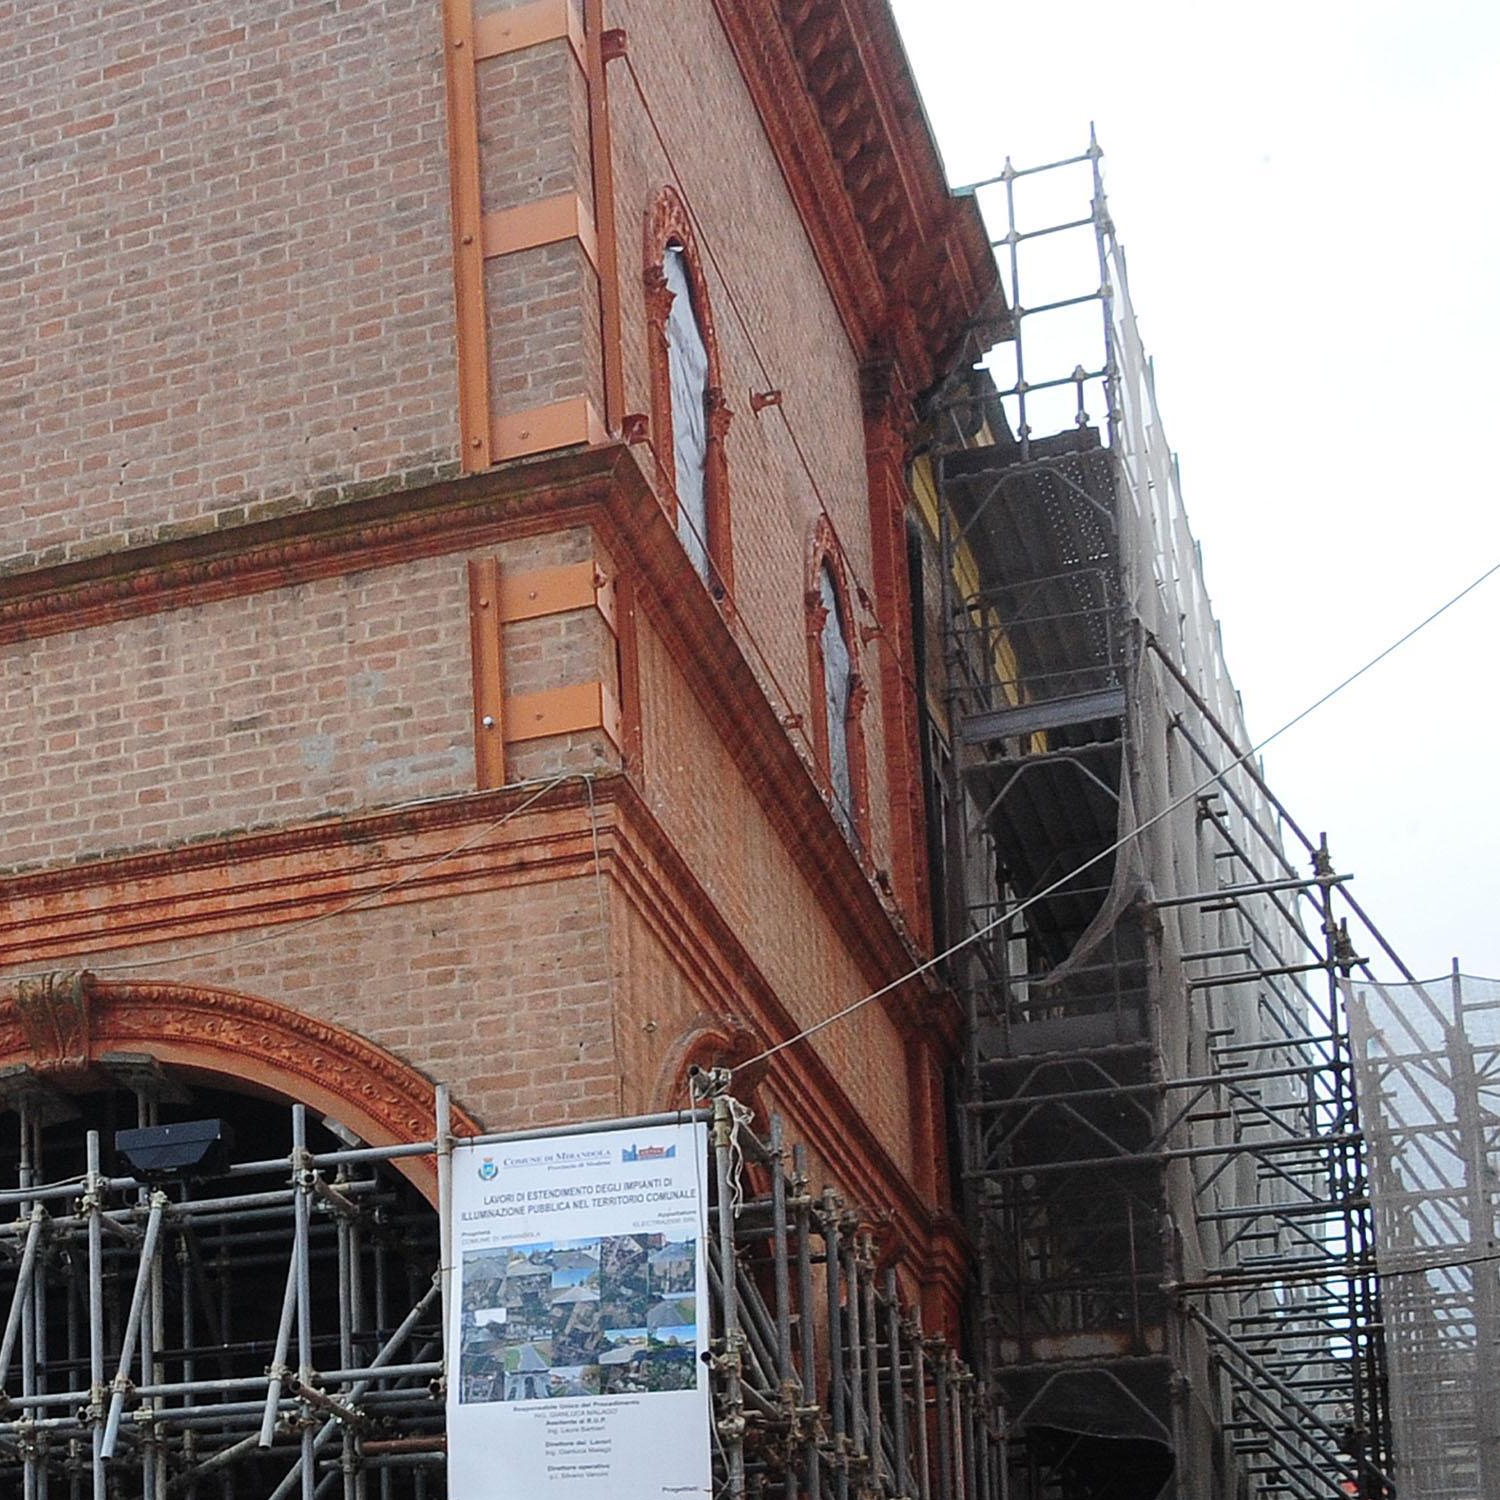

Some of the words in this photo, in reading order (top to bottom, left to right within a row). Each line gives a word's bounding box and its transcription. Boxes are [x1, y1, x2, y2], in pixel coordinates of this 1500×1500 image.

[461, 1204, 526, 1221] ILLUMINAZIONE
[527, 1199, 571, 1214] PUBBLICA
[573, 1197, 590, 1208] NEL
[592, 1191, 645, 1207] TERRITORIO
[646, 1188, 697, 1202] COMUNALE
[484, 1193, 514, 1206] LAVORI
[516, 1192, 525, 1202] DI
[527, 1185, 593, 1201] ESTENDIMENTO
[595, 1182, 622, 1195] DEGLI
[623, 1178, 662, 1191] IMPIANTI
[663, 1177, 673, 1187] DI
